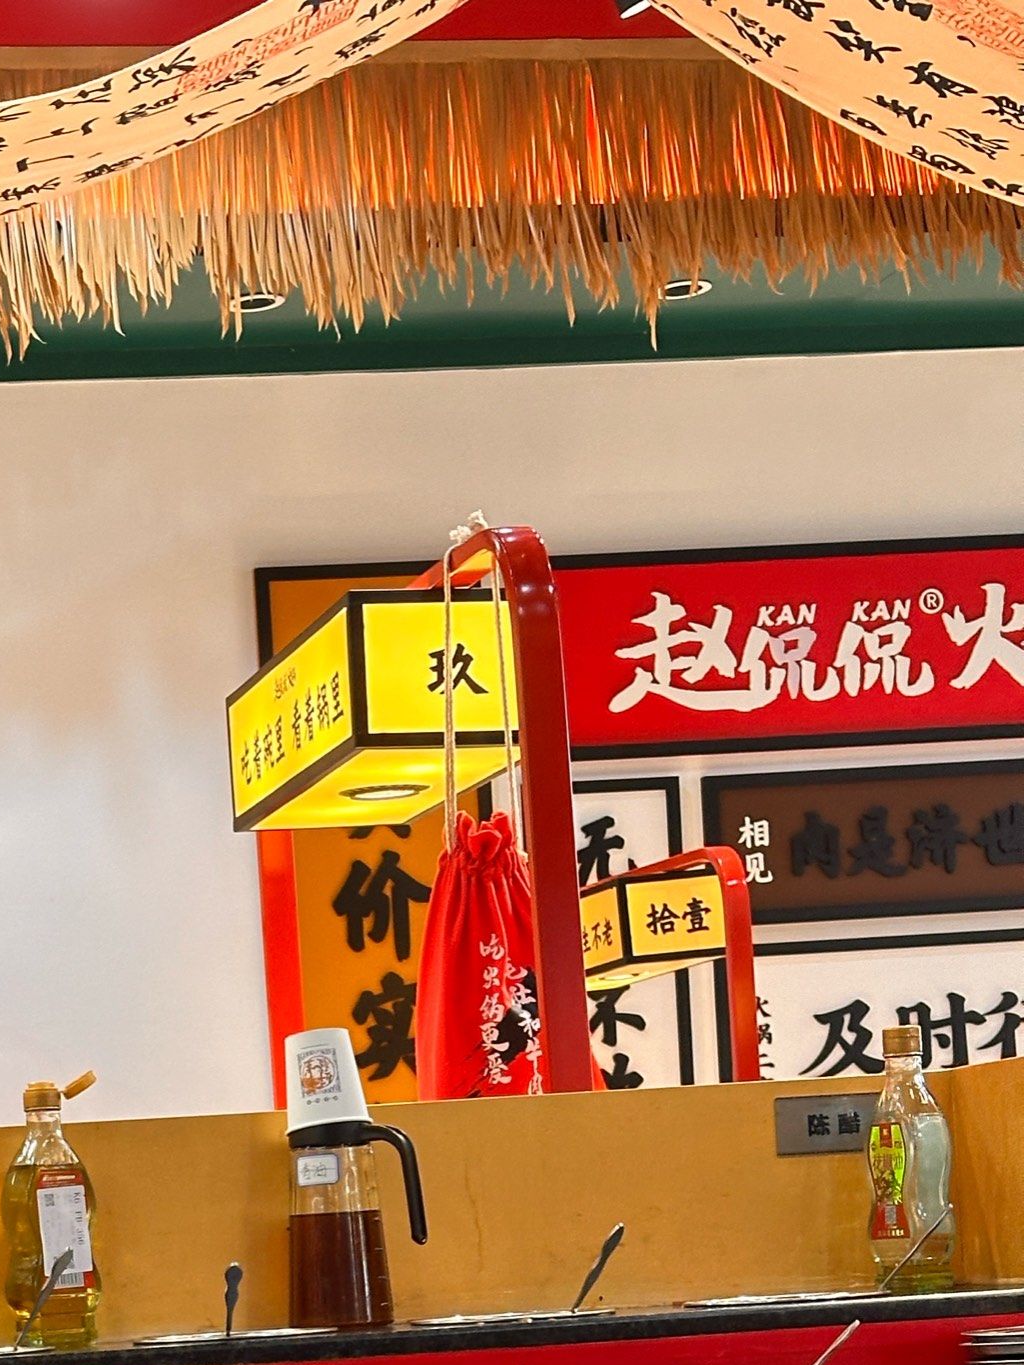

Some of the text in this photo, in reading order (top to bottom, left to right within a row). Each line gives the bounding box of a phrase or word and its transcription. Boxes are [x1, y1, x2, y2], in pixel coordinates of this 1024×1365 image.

[757, 599, 911, 627] KAN KAN
[427, 644, 489, 695] 玖
[738, 816, 774, 883] 相见
[647, 897, 712, 936] 拾壹
